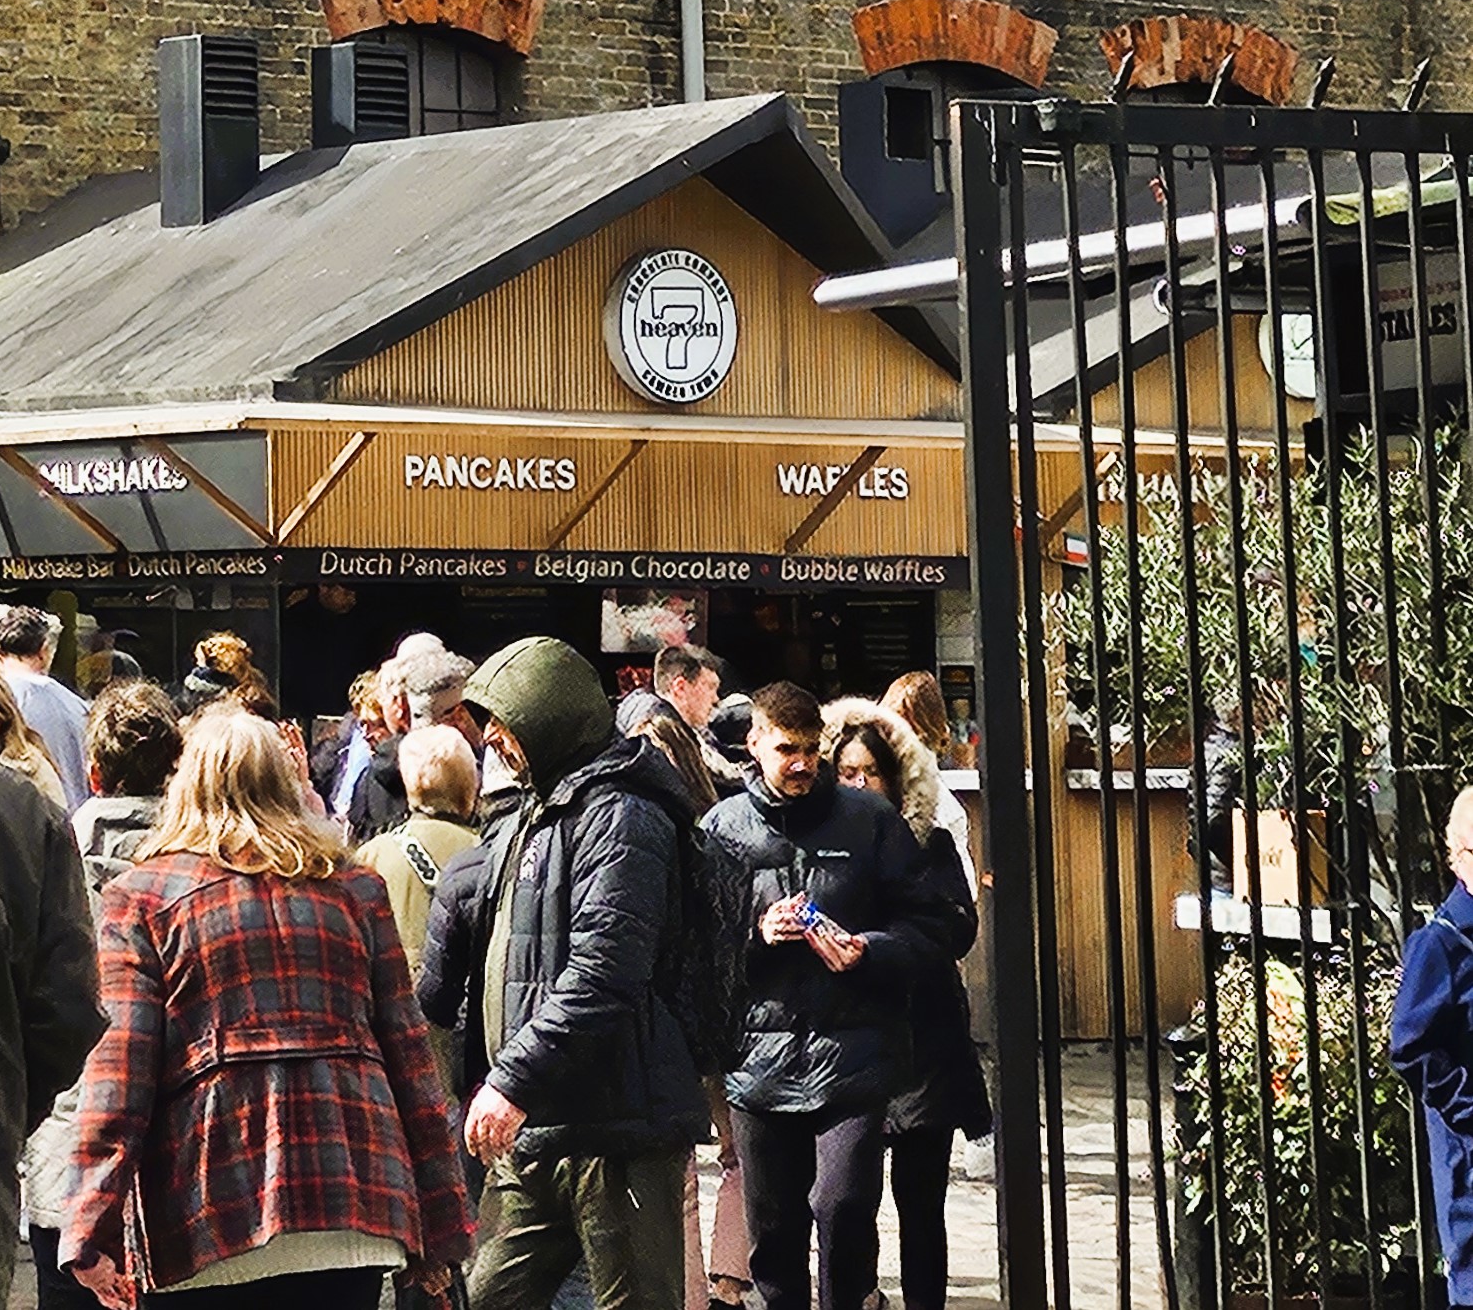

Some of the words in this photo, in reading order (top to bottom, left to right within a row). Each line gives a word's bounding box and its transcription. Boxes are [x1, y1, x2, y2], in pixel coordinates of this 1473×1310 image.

[640, 319, 718, 338] heaven
[38, 456, 189, 496] MILKSHAKES
[404, 454, 577, 491] PANCAKES
[777, 463, 910, 499] WAFLES
[1, 557, 84, 580] Milkshake
[86, 555, 115, 578] Bar
[128, 554, 182, 577] Dutch
[185, 553, 267, 577] Pancakes
[320, 551, 392, 576] Dutch
[399, 552, 507, 577] Pancakes
[534, 552, 624, 583] Belgian
[630, 555, 751, 581] Chocolate
[780, 557, 859, 582] Bubble
[863, 558, 946, 583] Waffles
